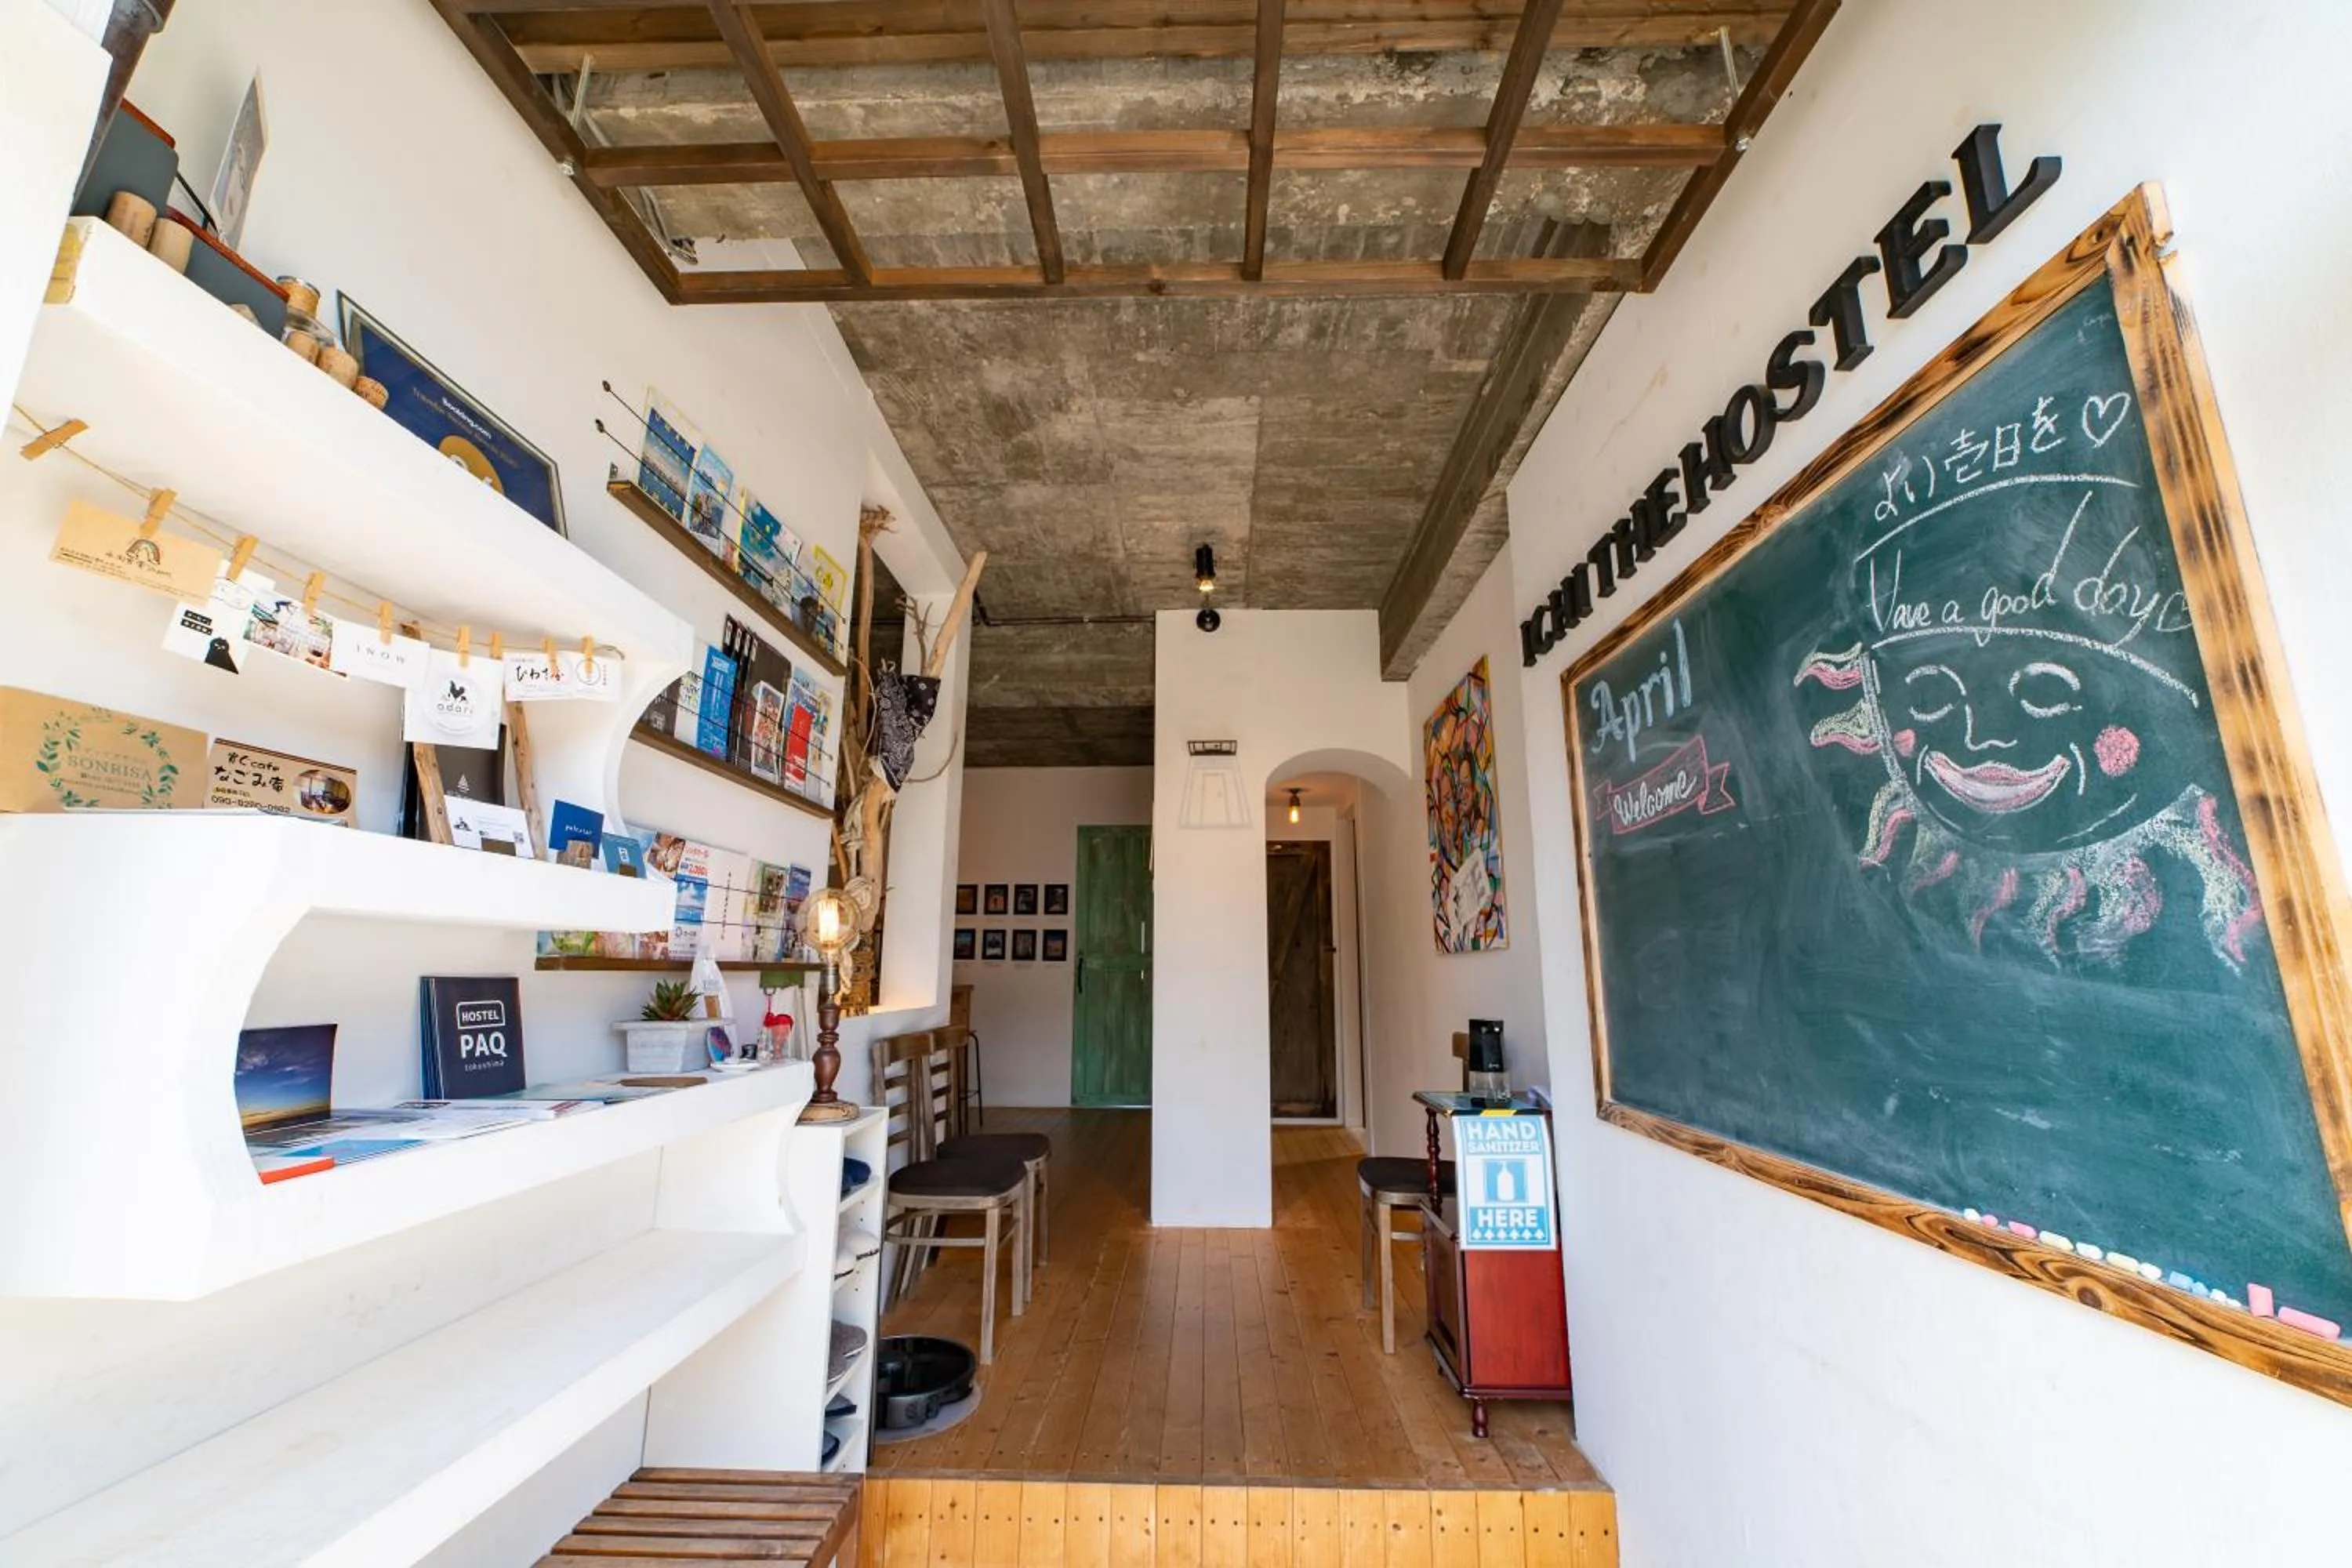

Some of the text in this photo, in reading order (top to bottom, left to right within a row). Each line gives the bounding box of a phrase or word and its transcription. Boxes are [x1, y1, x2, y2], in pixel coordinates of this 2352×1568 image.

[1941, 600, 1965, 623] a
[1980, 490, 2094, 648] good
[1590, 616, 1692, 764] April
[67, 754, 153, 782] SONRISA
[1613, 770, 1697, 826] Welcome
[462, 1009, 499, 1022] HOSTEL
[459, 1031, 509, 1059] PAQ
[1465, 1120, 1536, 1141] HAND
[1468, 1140, 1541, 1153] SANITIZER
[1477, 1208, 1539, 1229] HERE
